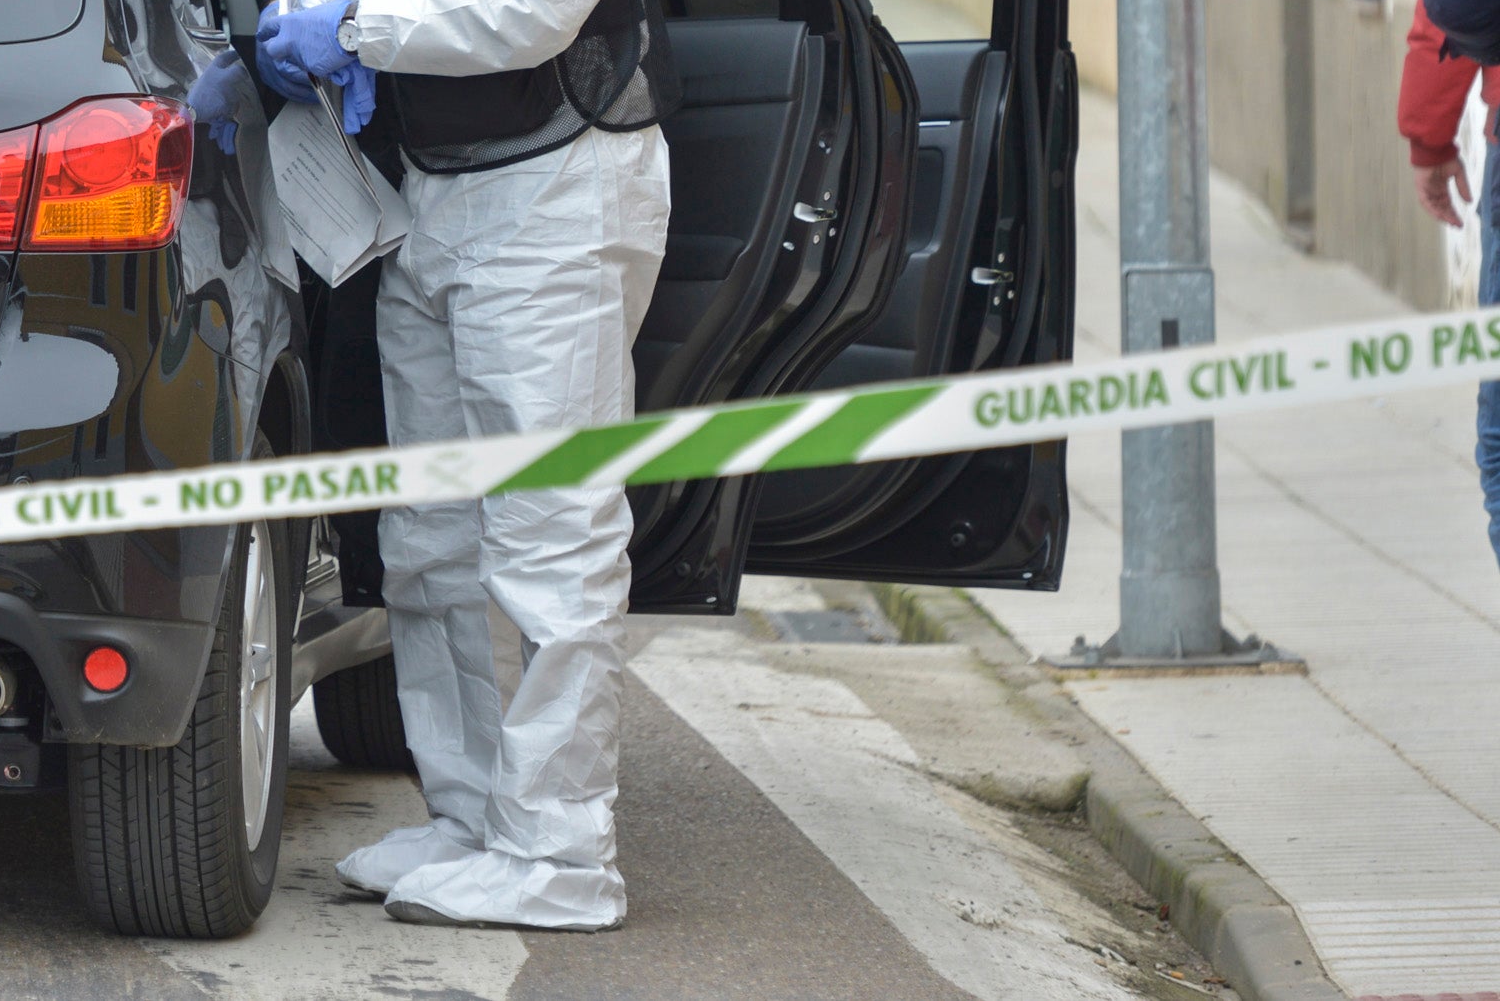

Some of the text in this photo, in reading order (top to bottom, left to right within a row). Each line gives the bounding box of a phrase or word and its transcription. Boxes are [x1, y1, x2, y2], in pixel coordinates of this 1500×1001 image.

[974, 368, 1170, 428] GUARDIA
[1188, 350, 1295, 399] CIVIL
[1349, 332, 1413, 380] NO
[15, 488, 125, 524] CIVIL
[179, 477, 242, 513] NO
[263, 462, 400, 505] PASAR
